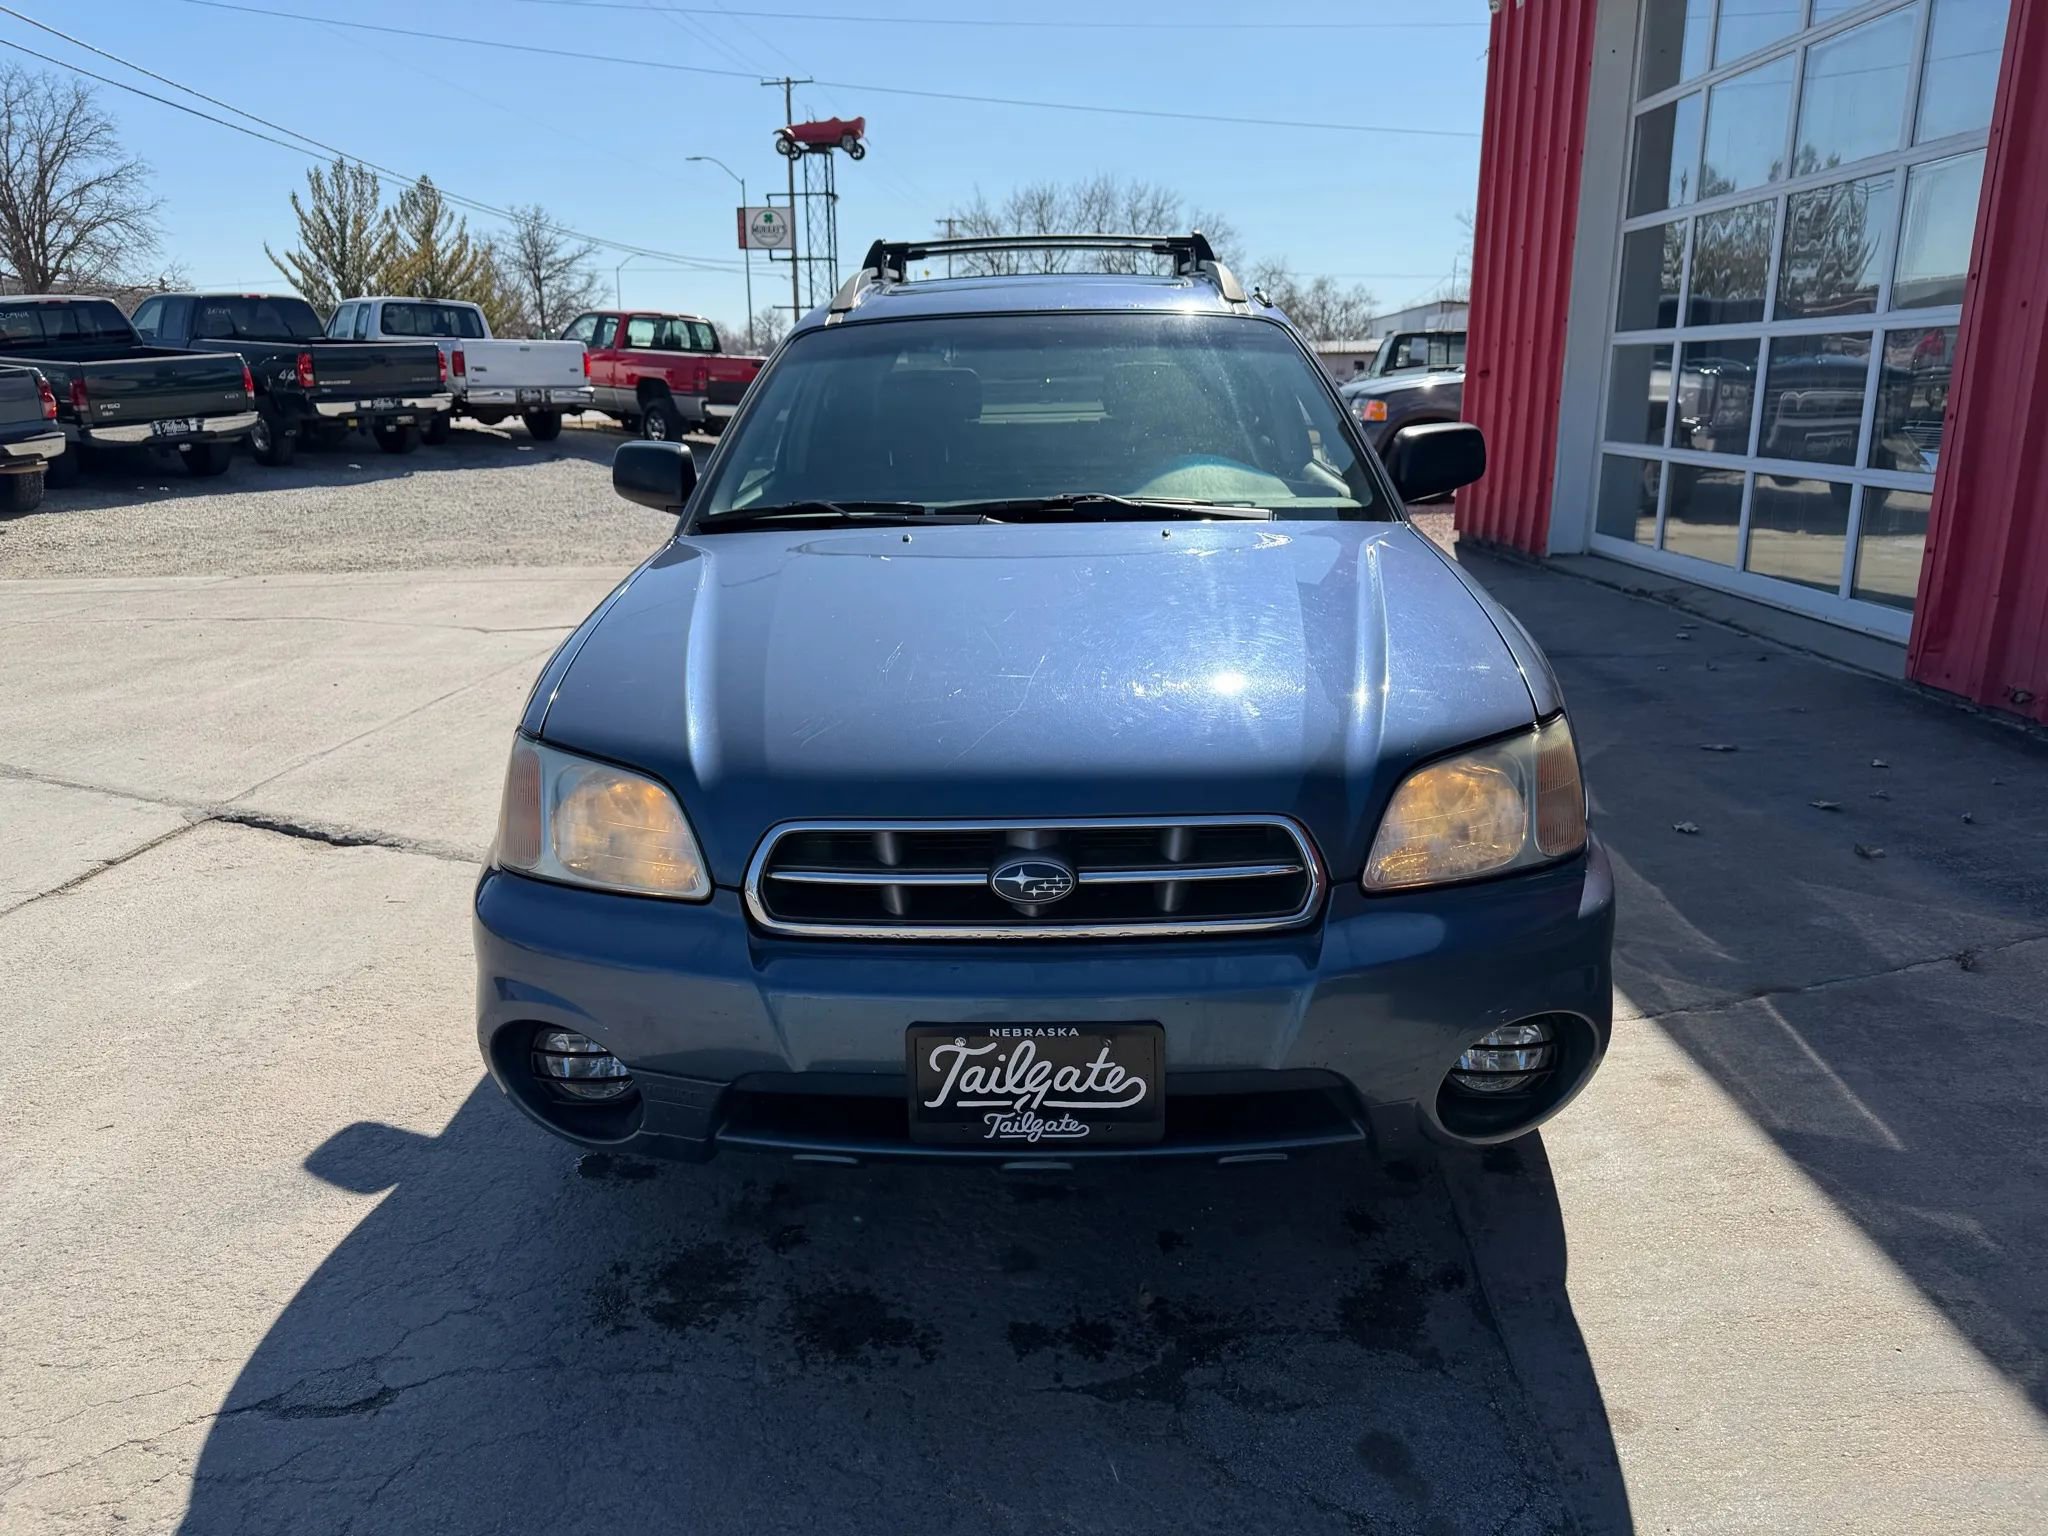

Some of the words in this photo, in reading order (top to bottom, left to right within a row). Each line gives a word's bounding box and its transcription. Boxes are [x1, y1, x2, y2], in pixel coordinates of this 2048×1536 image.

[989, 1027, 1080, 1037] NEBRASKA
[924, 1040, 1147, 1113] Tailgate
[983, 1111, 1090, 1143] Tailgate
